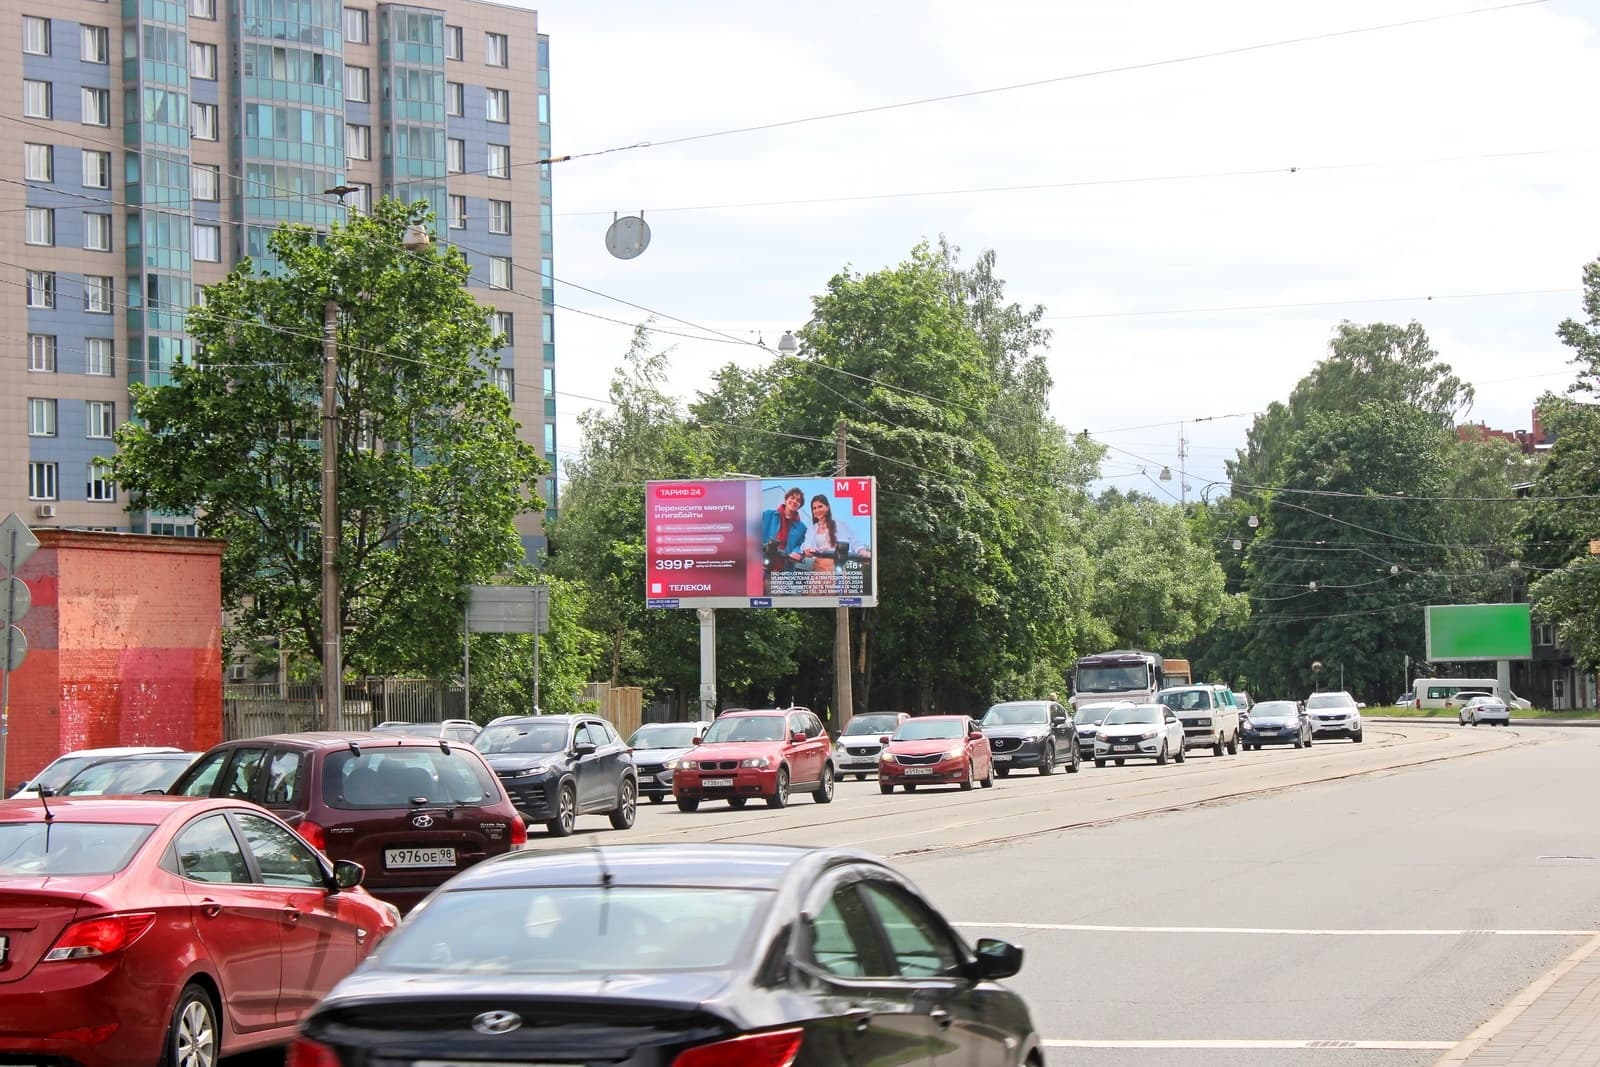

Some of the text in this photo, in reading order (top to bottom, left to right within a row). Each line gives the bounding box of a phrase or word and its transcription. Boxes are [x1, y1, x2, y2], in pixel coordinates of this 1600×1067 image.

[660, 488, 701, 496] ТАРИФ 24
[654, 504, 735, 513] Переносите минуты
[661, 511, 703, 519] гигабайты
[668, 584, 711, 592] ТЕЛЕКОМ
